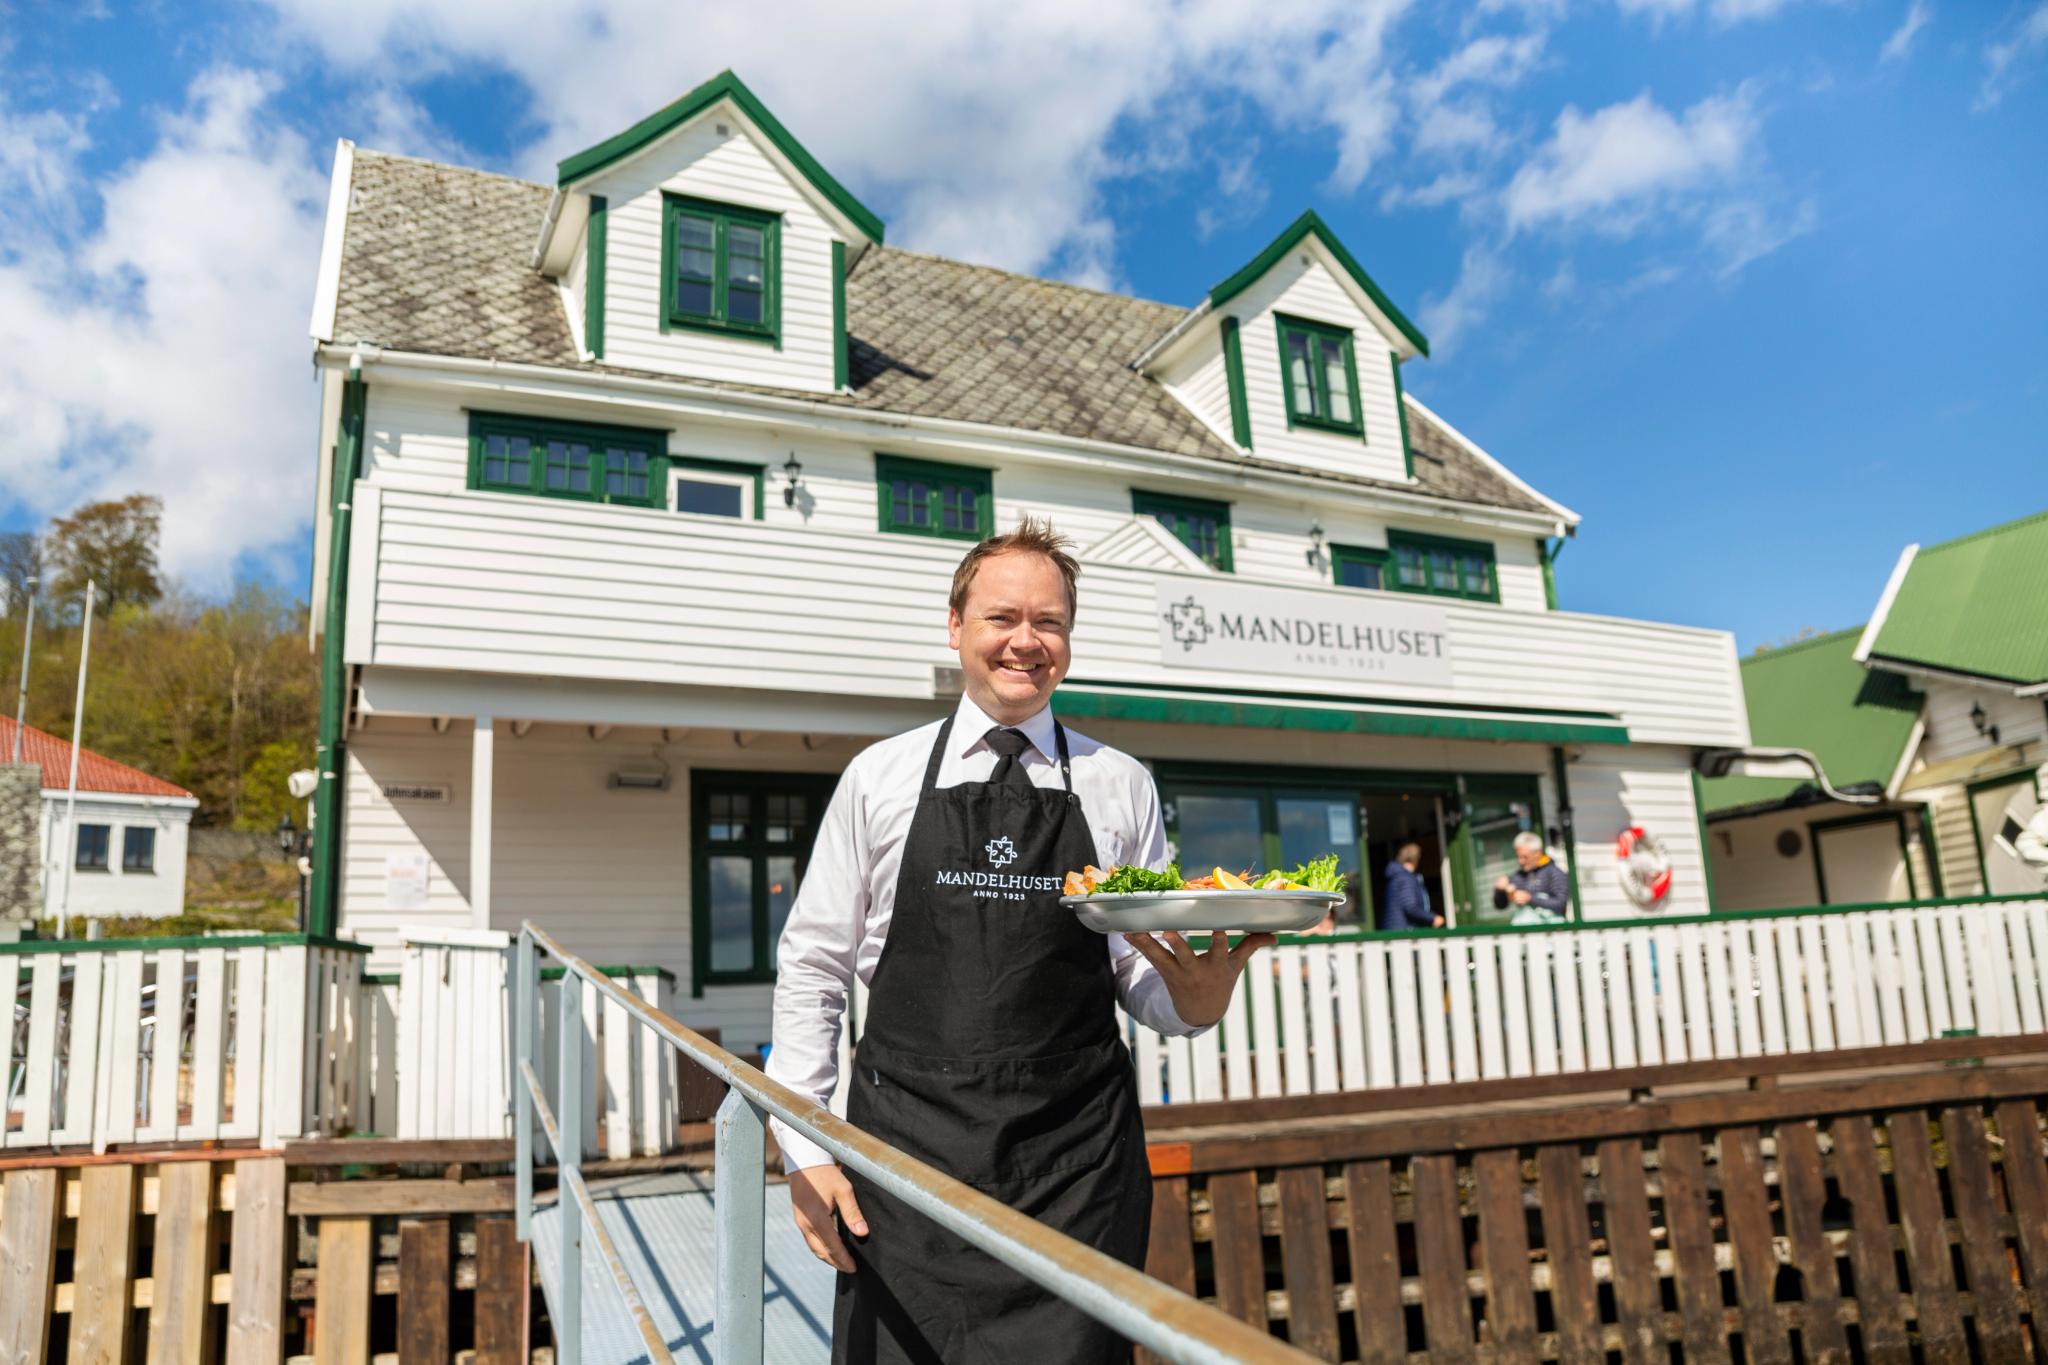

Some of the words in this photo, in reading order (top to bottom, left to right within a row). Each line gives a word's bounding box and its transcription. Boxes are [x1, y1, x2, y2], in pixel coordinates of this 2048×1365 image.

[1220, 612, 1446, 658] MANDELHUSET
[1295, 652, 1339, 667] ANNO
[936, 871, 1063, 890] MANDELHUSET
[973, 890, 999, 899] ANNO
